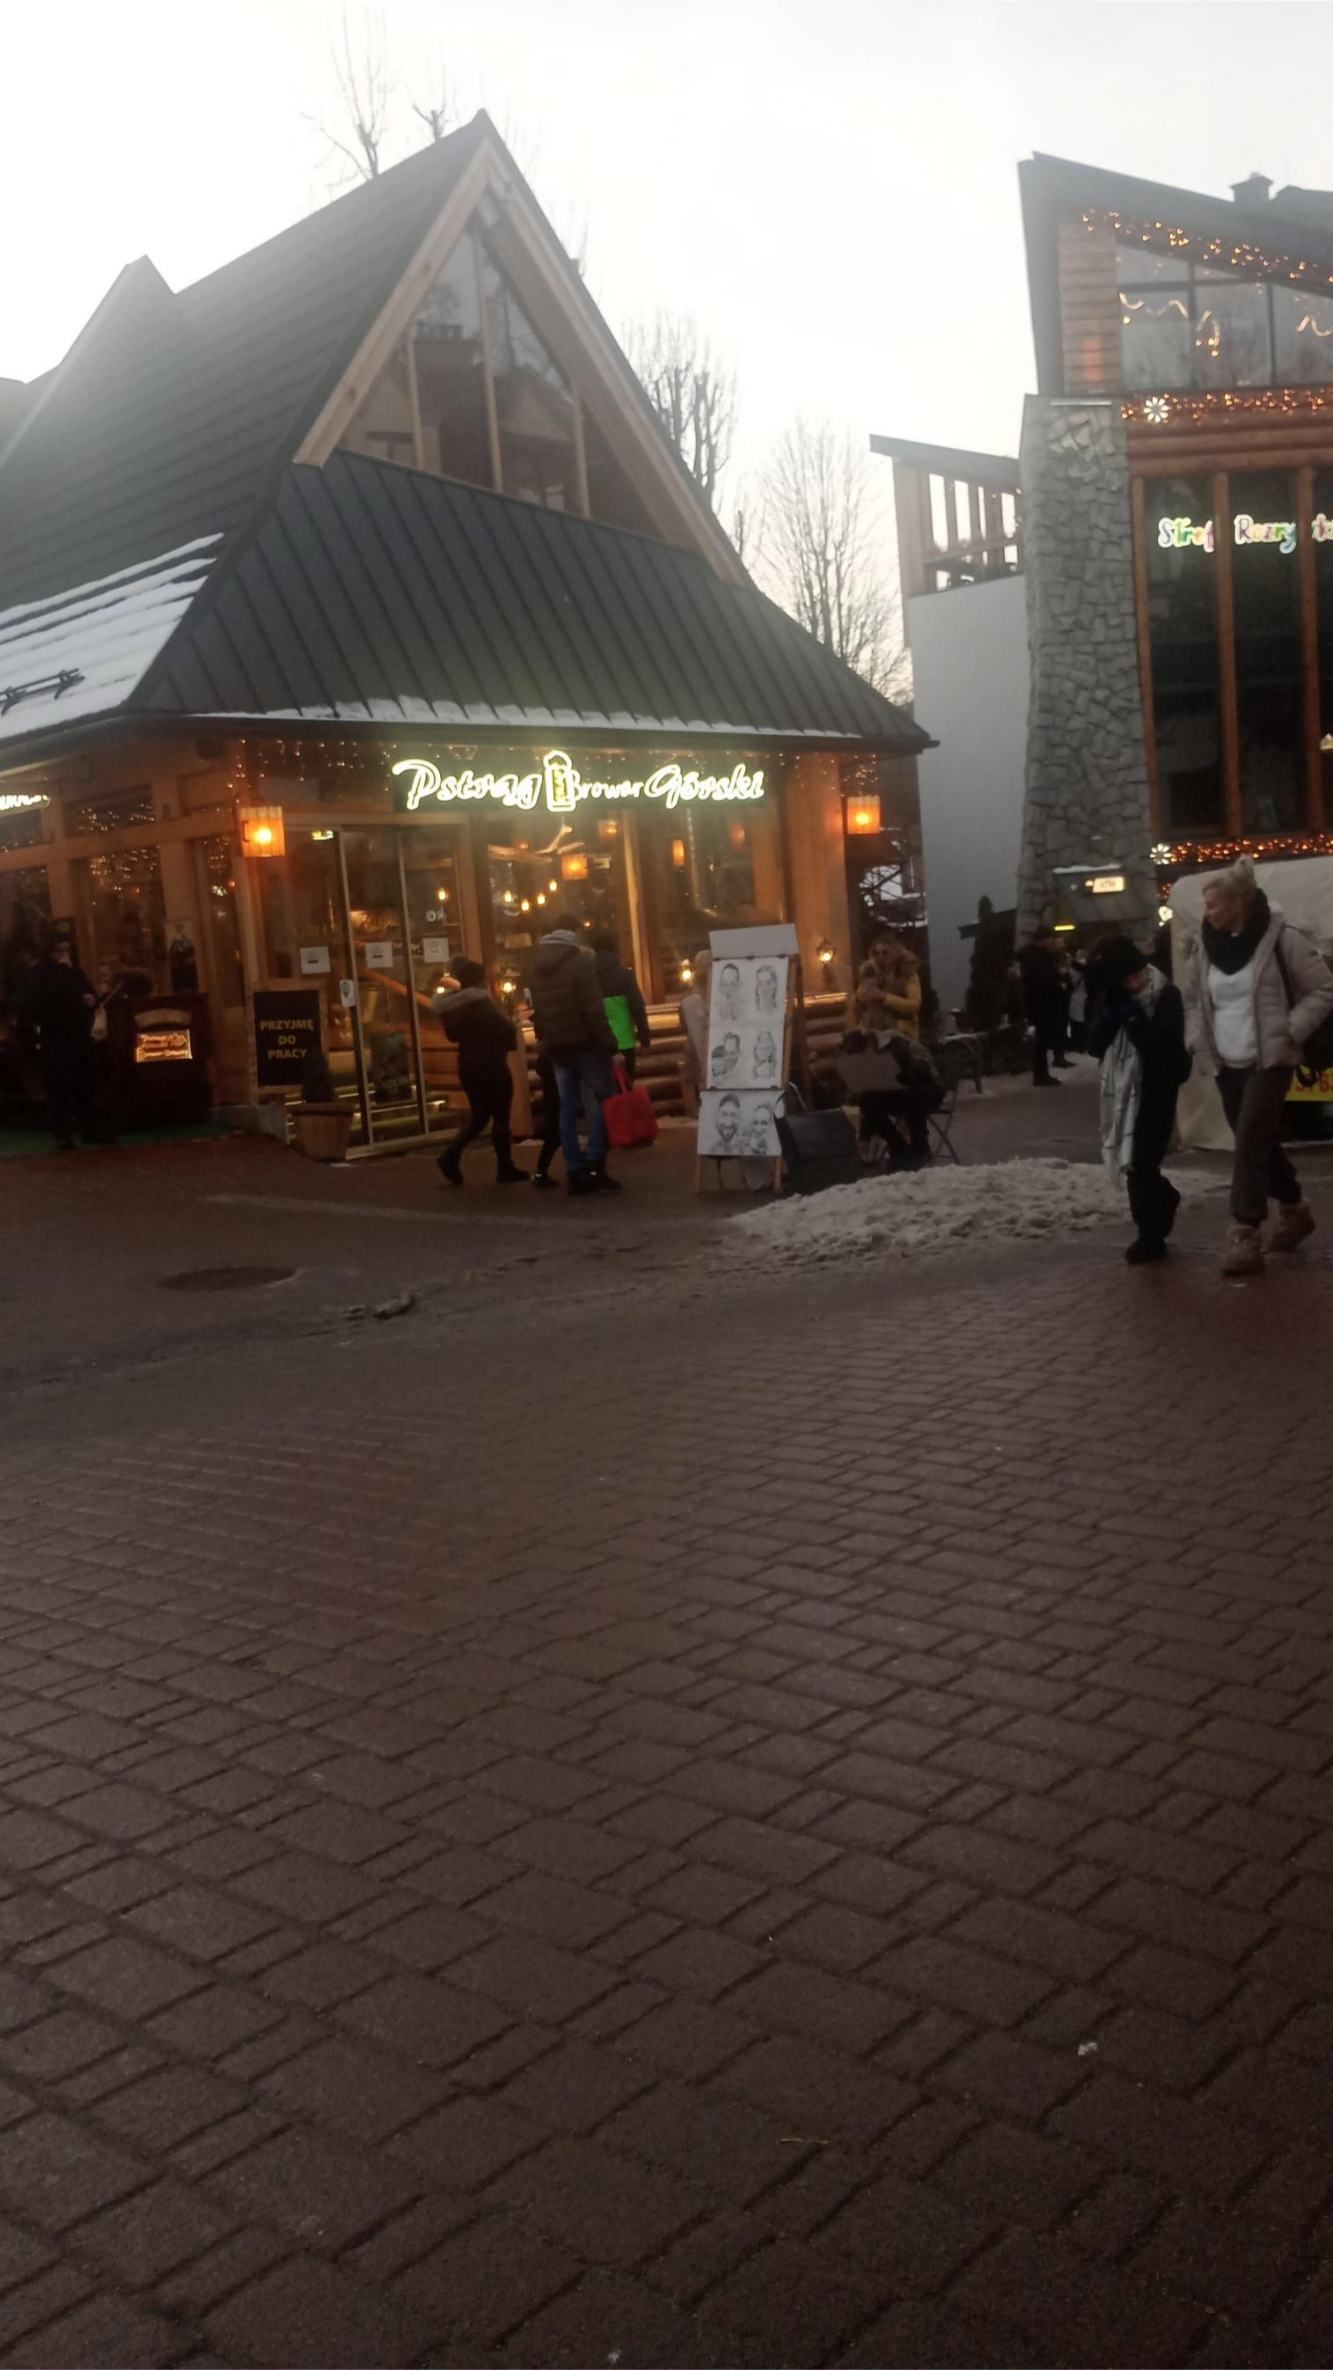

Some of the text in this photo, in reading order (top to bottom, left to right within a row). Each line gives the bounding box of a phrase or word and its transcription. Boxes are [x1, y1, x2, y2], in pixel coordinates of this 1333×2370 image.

[260, 1019, 314, 1032] PRZYJMĘ
[278, 1035, 297, 1045] DO
[267, 1048, 307, 1059] PRACY
